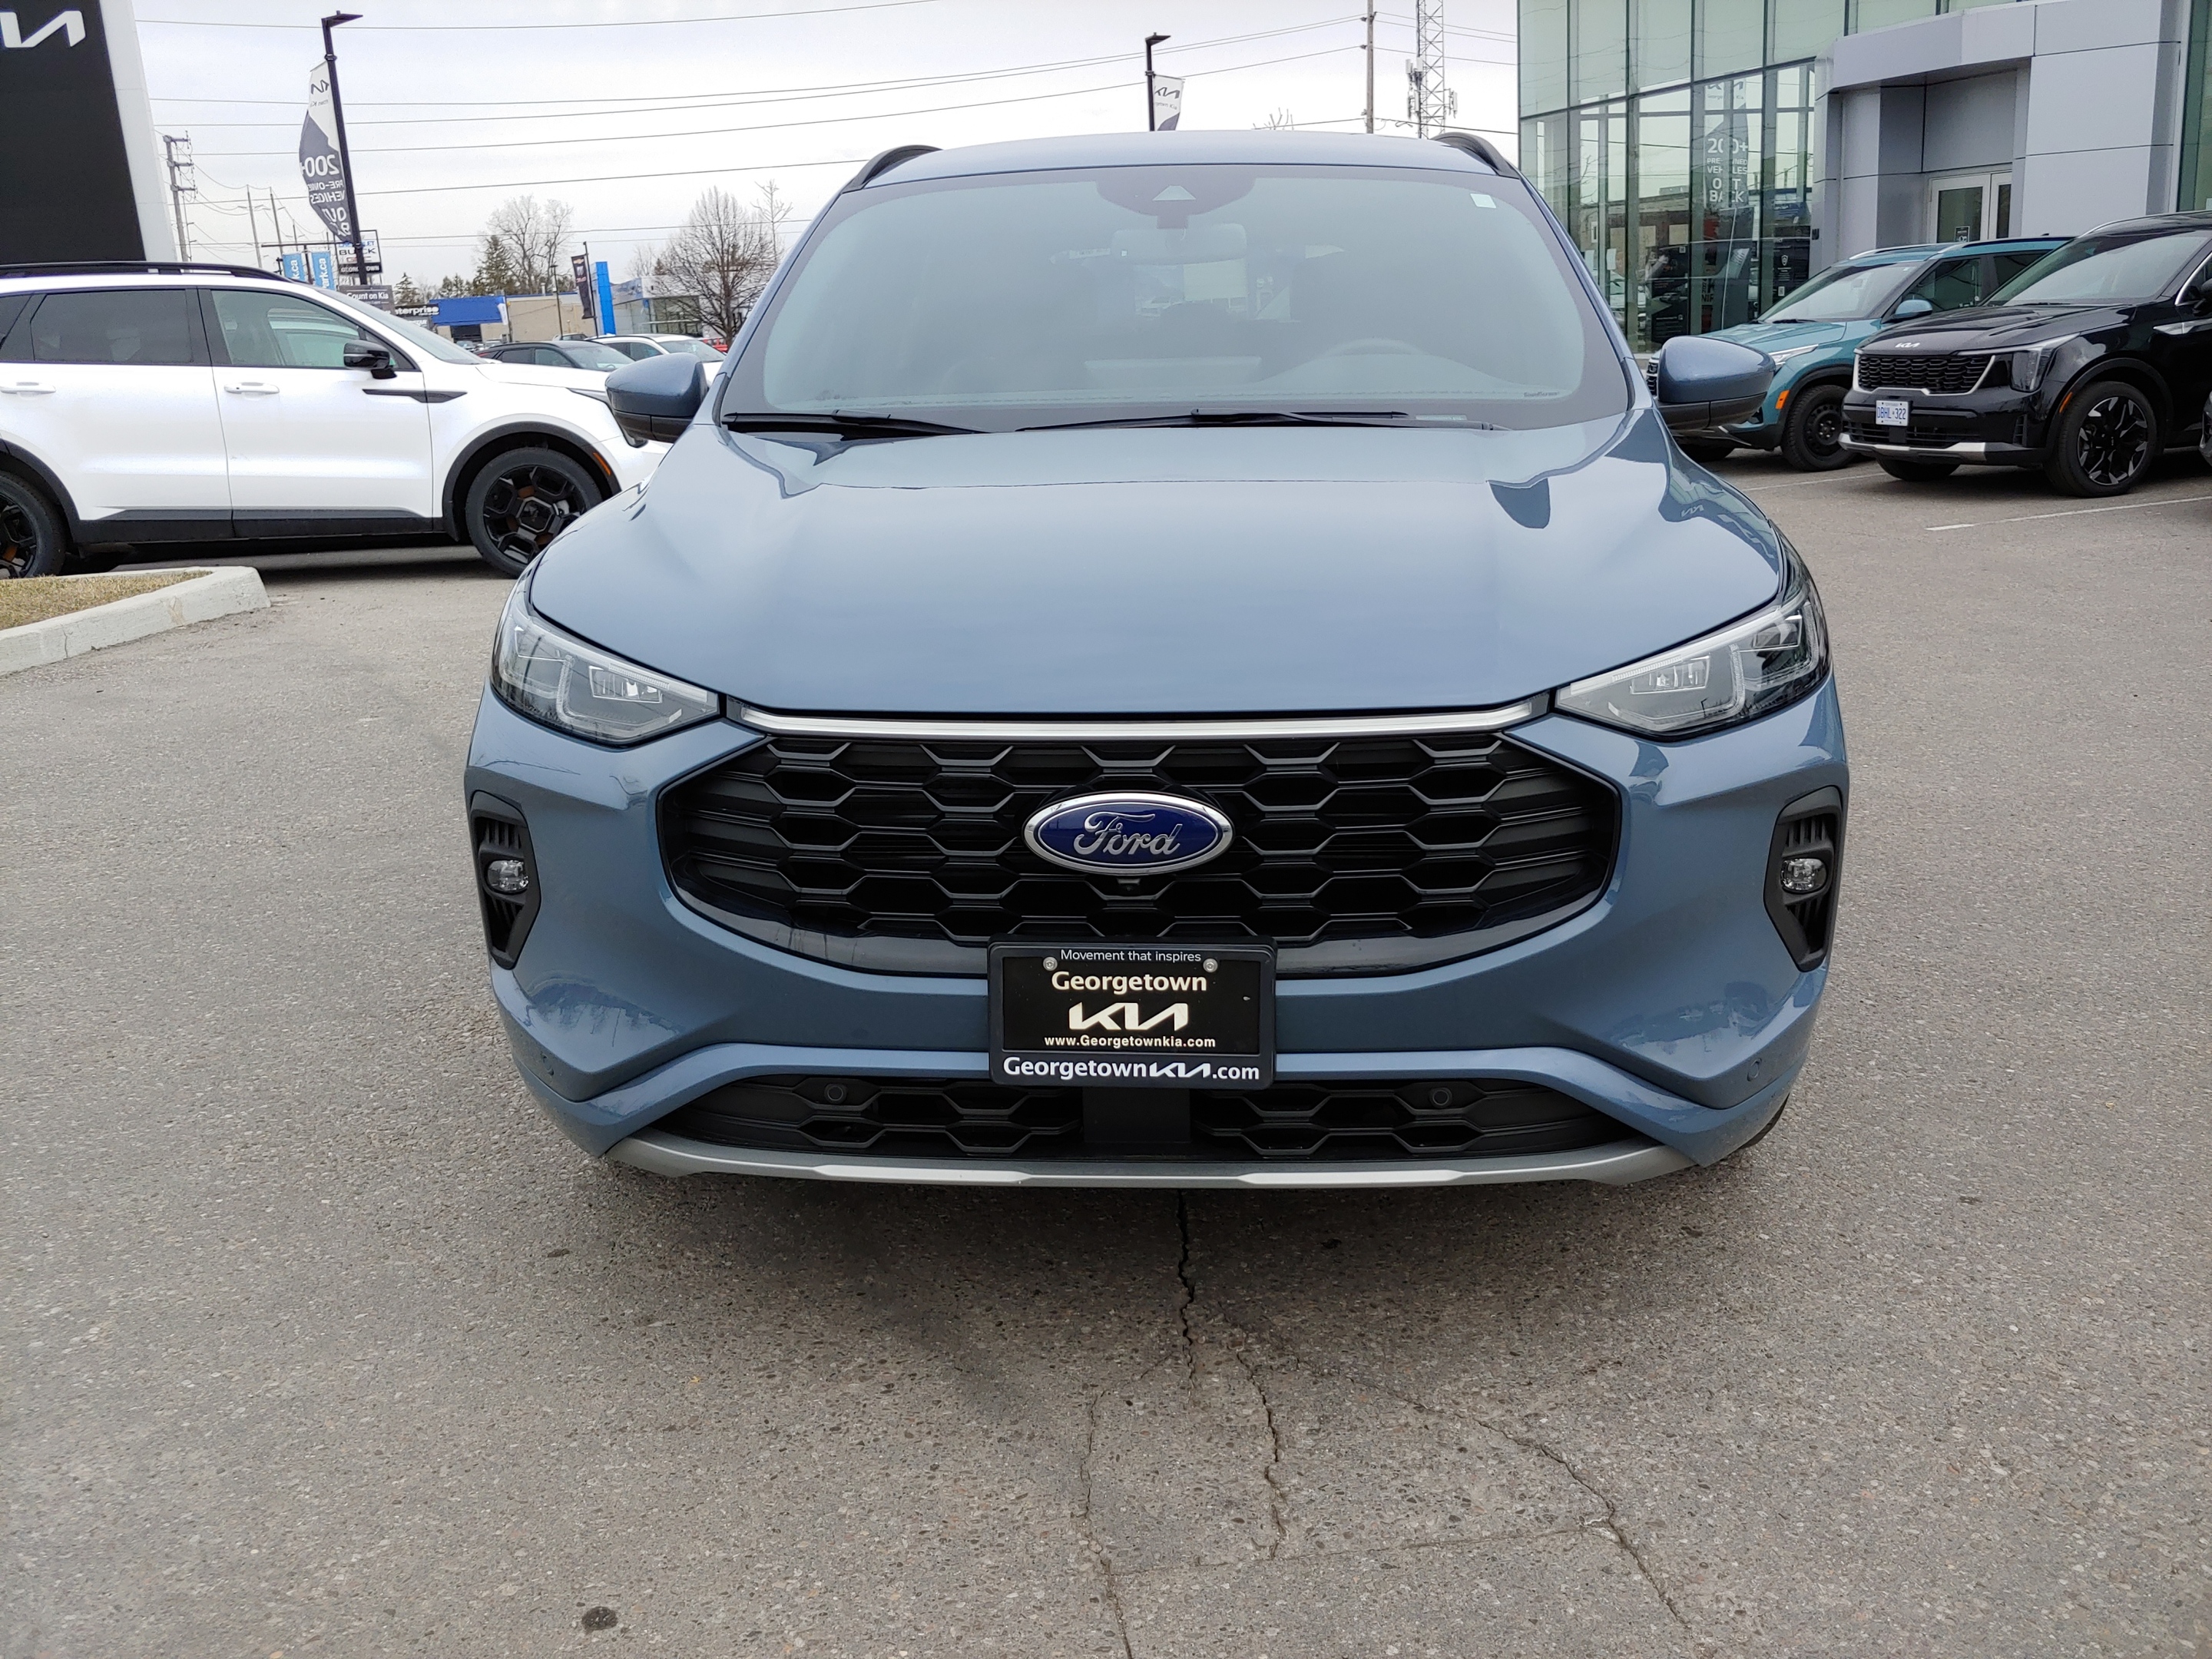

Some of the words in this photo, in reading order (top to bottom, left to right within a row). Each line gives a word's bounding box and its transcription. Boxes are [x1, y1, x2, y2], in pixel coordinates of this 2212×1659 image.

[1712, 177, 1741, 190] OT
[395, 306, 439, 316] nterprise
[1895, 408, 1906, 420] 322
[1073, 811, 1183, 855] Ford
[1061, 949, 1125, 960] Movement
[1128, 950, 1152, 961] that
[1155, 951, 1201, 963] inspires
[1051, 971, 1207, 995] Georgetown
[1068, 1002, 1188, 1031] KIA
[1044, 1035, 1216, 1048] www.Georgetownkia.com
